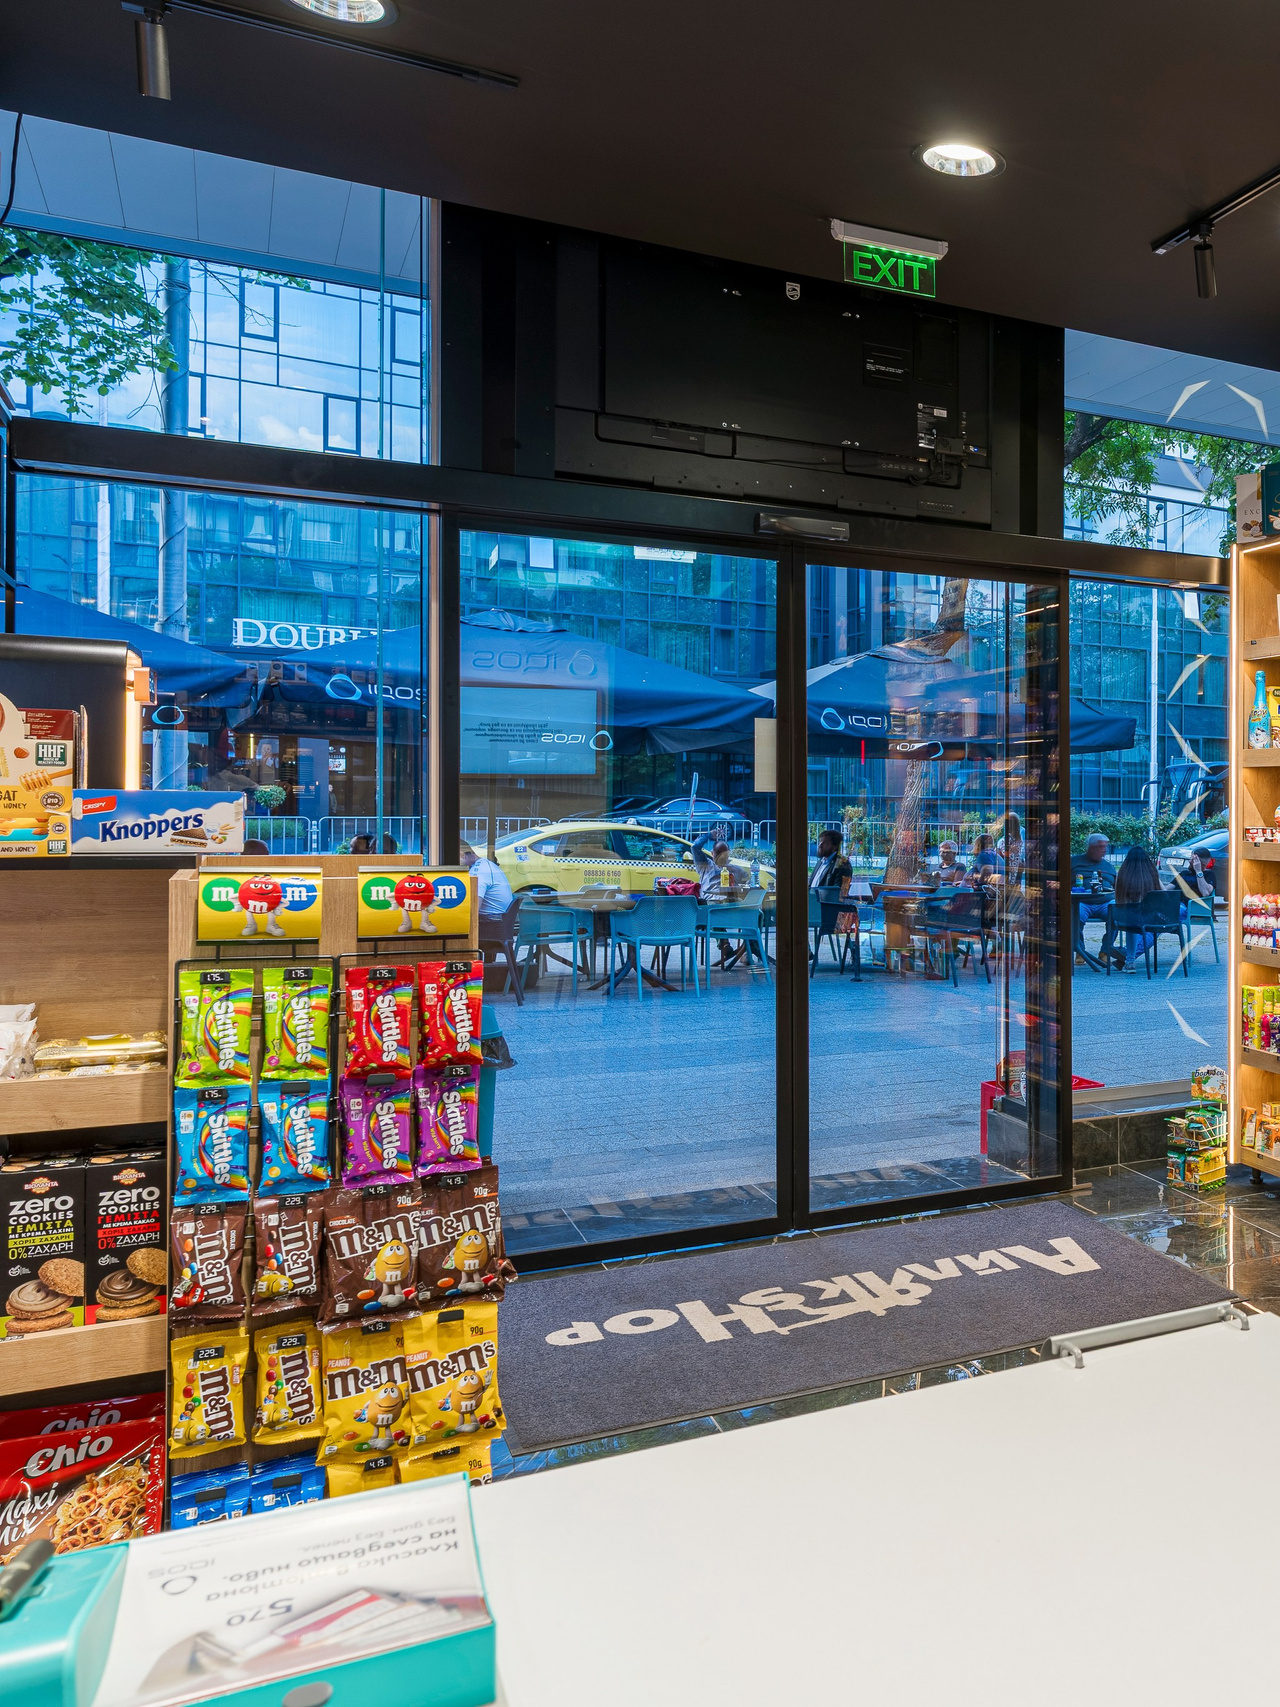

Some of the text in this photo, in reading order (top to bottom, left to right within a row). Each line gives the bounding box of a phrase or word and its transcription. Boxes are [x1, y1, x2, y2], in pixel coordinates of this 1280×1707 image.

[853, 250, 927, 290] EXIT
[38, 745, 64, 757] HHF
[83, 801, 106, 810] CRISPY
[100, 813, 204, 843] Knoppers
[49, 841, 65, 849] HHF
[285, 885, 307, 901] m
[438, 884, 457, 899] m
[376, 994, 399, 1062] Skittles
[448, 987, 471, 1053] Skittles
[213, 1000, 235, 1070] Skittles
[290, 996, 312, 1063] Skittles
[289, 1105, 313, 1175] Skittles
[209, 1114, 232, 1185] Skittles
[98, 1187, 160, 1206] zero
[397, 1195, 412, 1205] 90g
[474, 1187, 488, 1197] 90g
[9, 1196, 74, 1215] zero
[99, 1201, 160, 1215] COOKIES
[9, 1211, 73, 1225] COOKIES
[98, 1210, 159, 1224] ΓΕΜΙΣΤΑ
[8, 1220, 73, 1234] ΓΕΜΙΣΤΑ
[98, 1232, 160, 1249] 0% ΖΑΧΑΡΗ
[9, 1242, 73, 1259] 0% ΖΑΧΑΡΗ
[328, 1358, 350, 1368] PEANUT
[406, 1352, 429, 1362] PEANUT
[406, 1341, 497, 1394] m&m's
[23, 1435, 114, 1479] Chio
[223, 1527, 457, 1582] на следващо ниво.
[358, 1541, 458, 1571] Класика
[149, 1558, 216, 1580] IQOS
